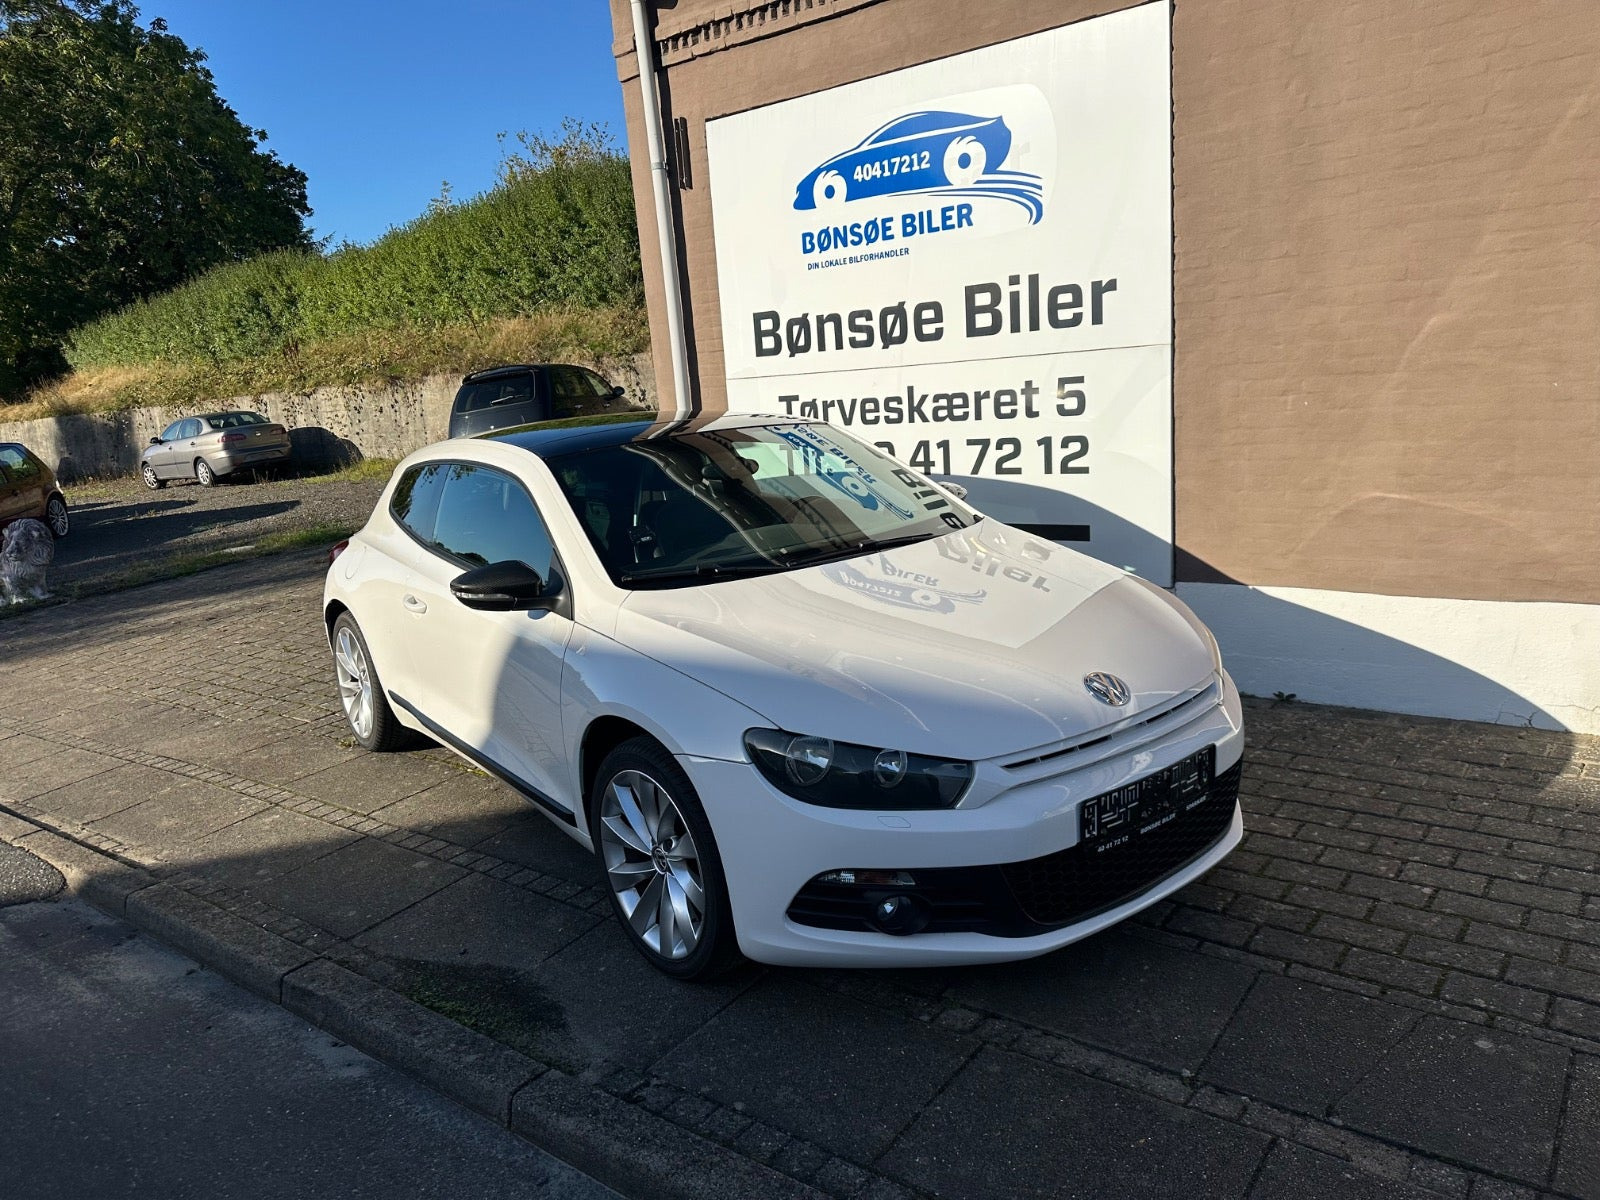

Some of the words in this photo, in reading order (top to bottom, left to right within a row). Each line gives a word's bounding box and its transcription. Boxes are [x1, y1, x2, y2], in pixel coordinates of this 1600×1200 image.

[853, 151, 931, 182] 40417212
[801, 216, 895, 254] BØNSØE
[901, 203, 974, 238] BILER
[807, 262, 820, 271] DIN
[820, 257, 848, 269] LOKALE
[848, 247, 910, 265] BILFORHANDLER
[753, 300, 944, 358] Bønsøe
[964, 274, 1118, 338] Biler
[1055, 376, 1087, 418] 5
[909, 439, 952, 476] 41
[968, 437, 1023, 476] 72
[1037, 435, 1091, 476] 12
